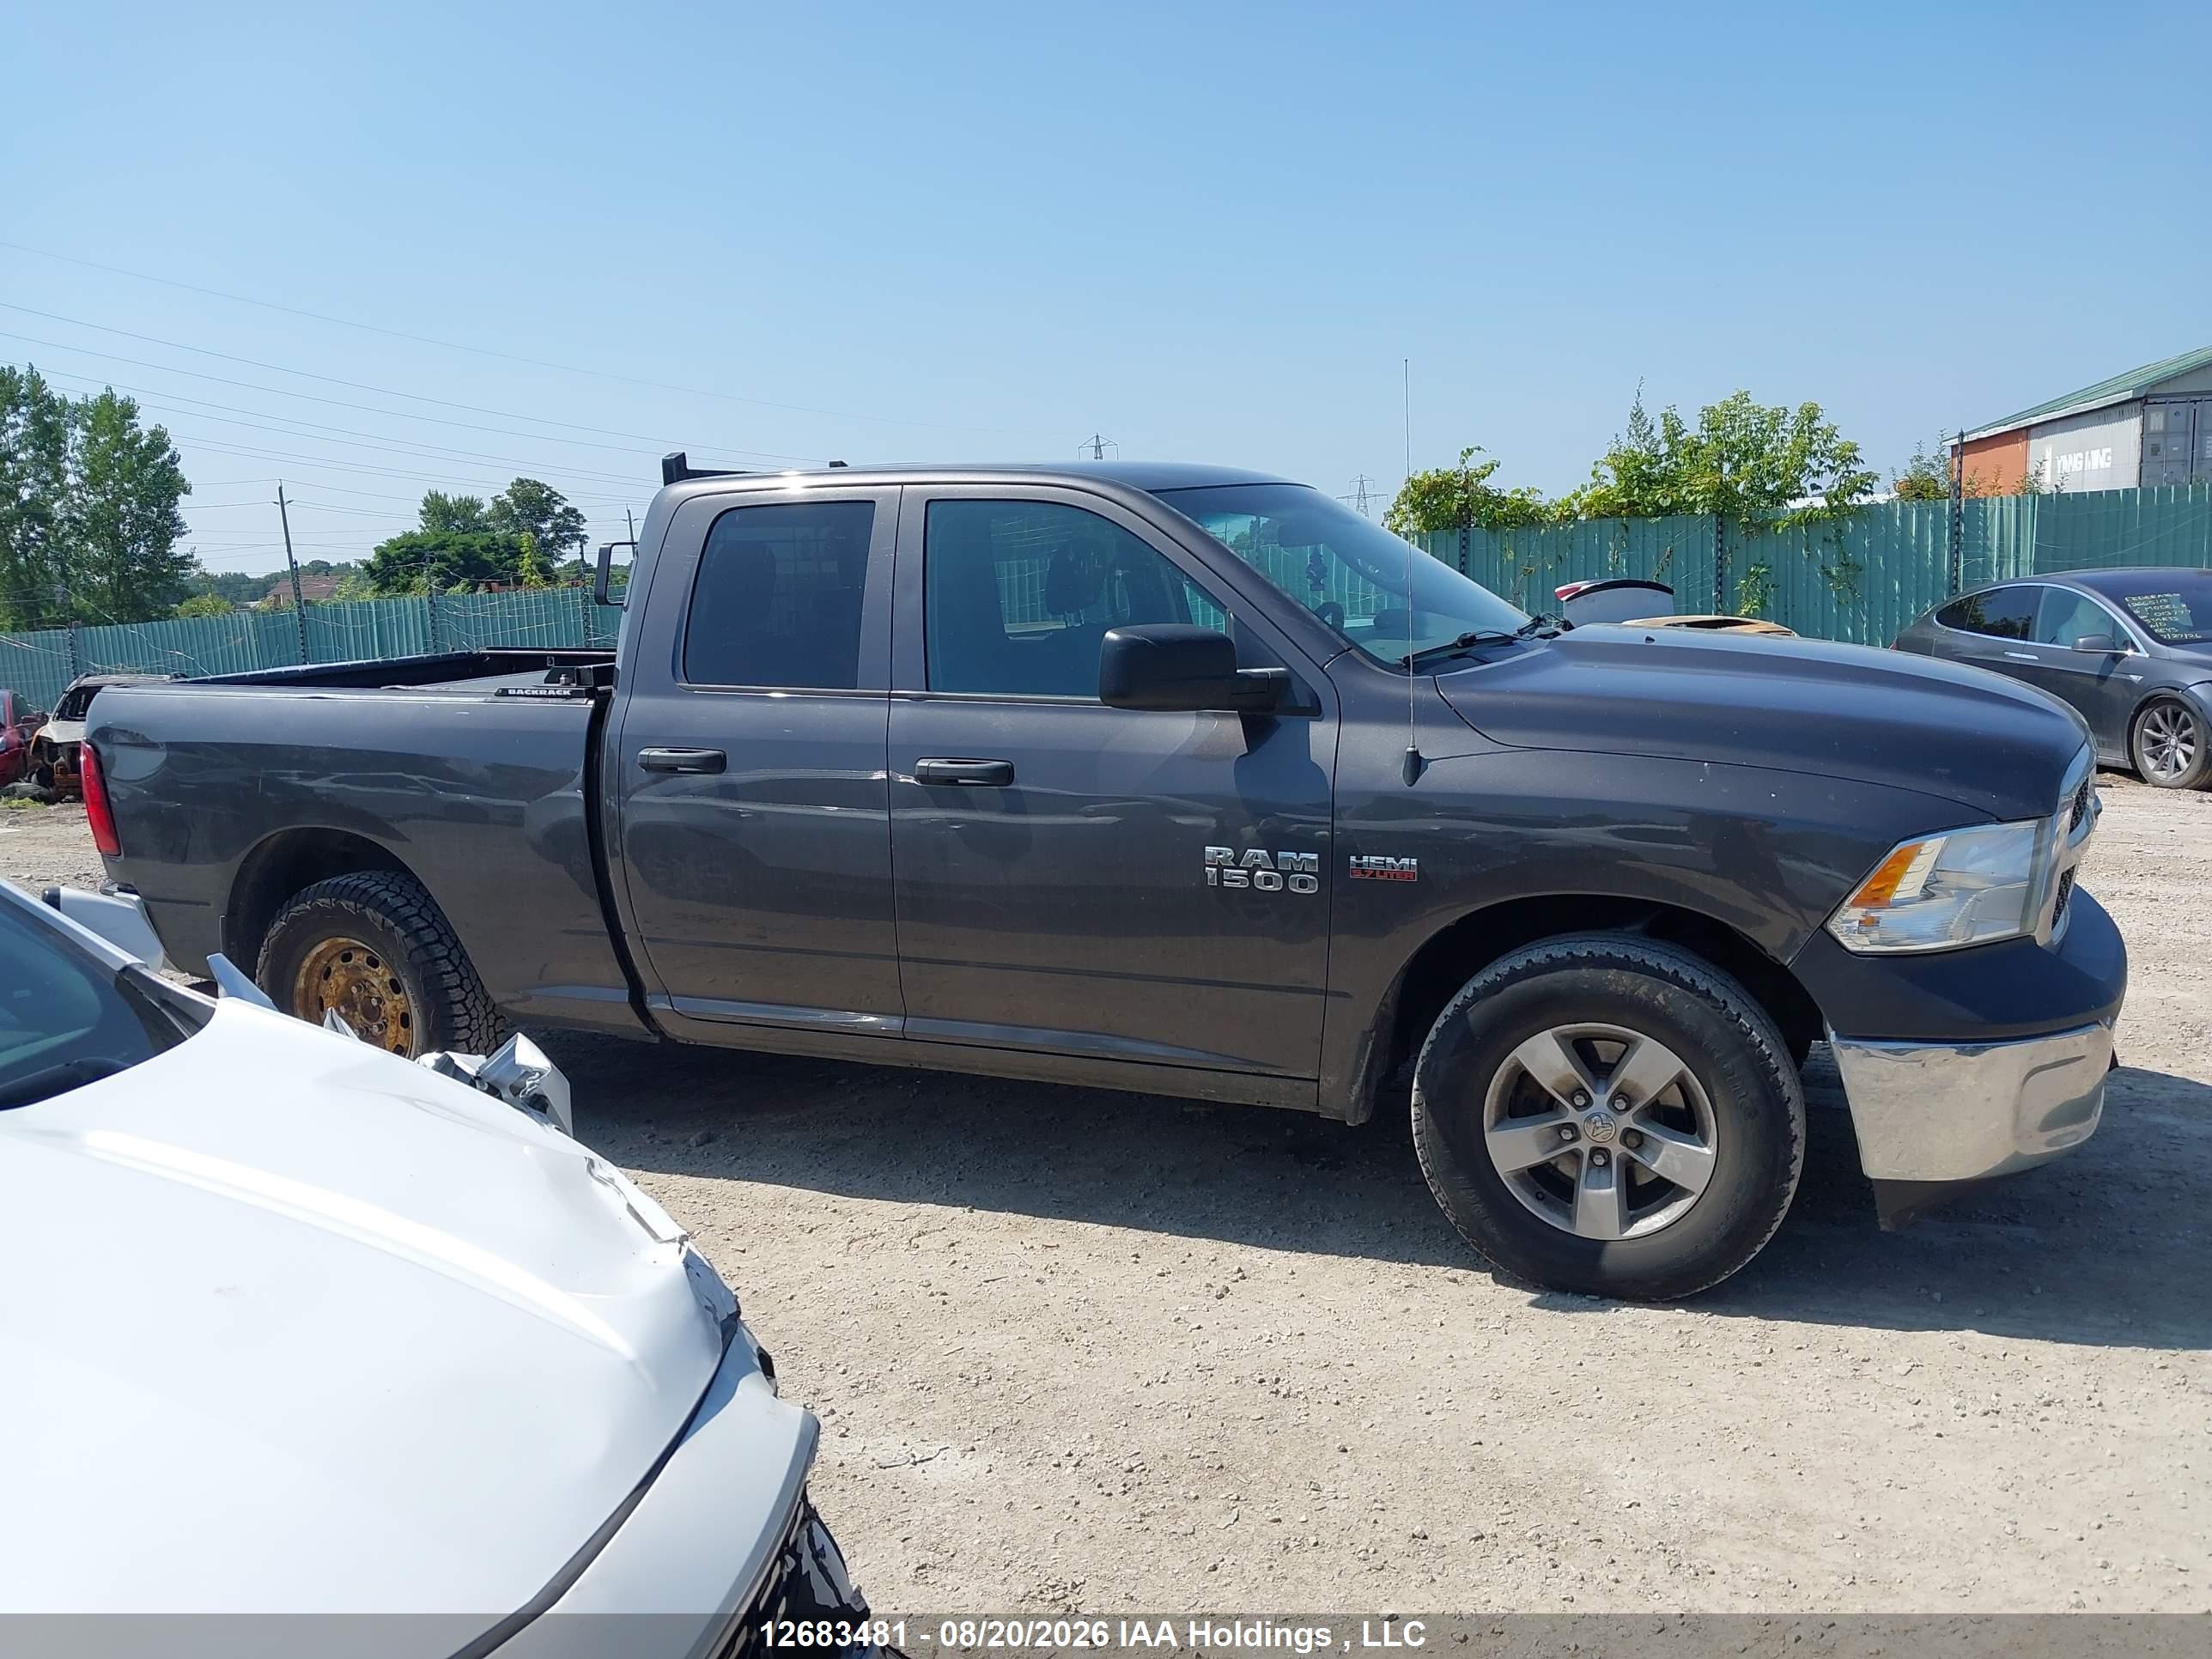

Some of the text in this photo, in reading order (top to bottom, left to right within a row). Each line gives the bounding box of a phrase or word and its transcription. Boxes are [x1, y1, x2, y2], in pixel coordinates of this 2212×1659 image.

[1205, 846, 1319, 872] RAM
[1350, 855, 1418, 871] HEMI
[1205, 866, 1319, 894] 1500
[1352, 869, 1415, 880] 5.7 LITER
